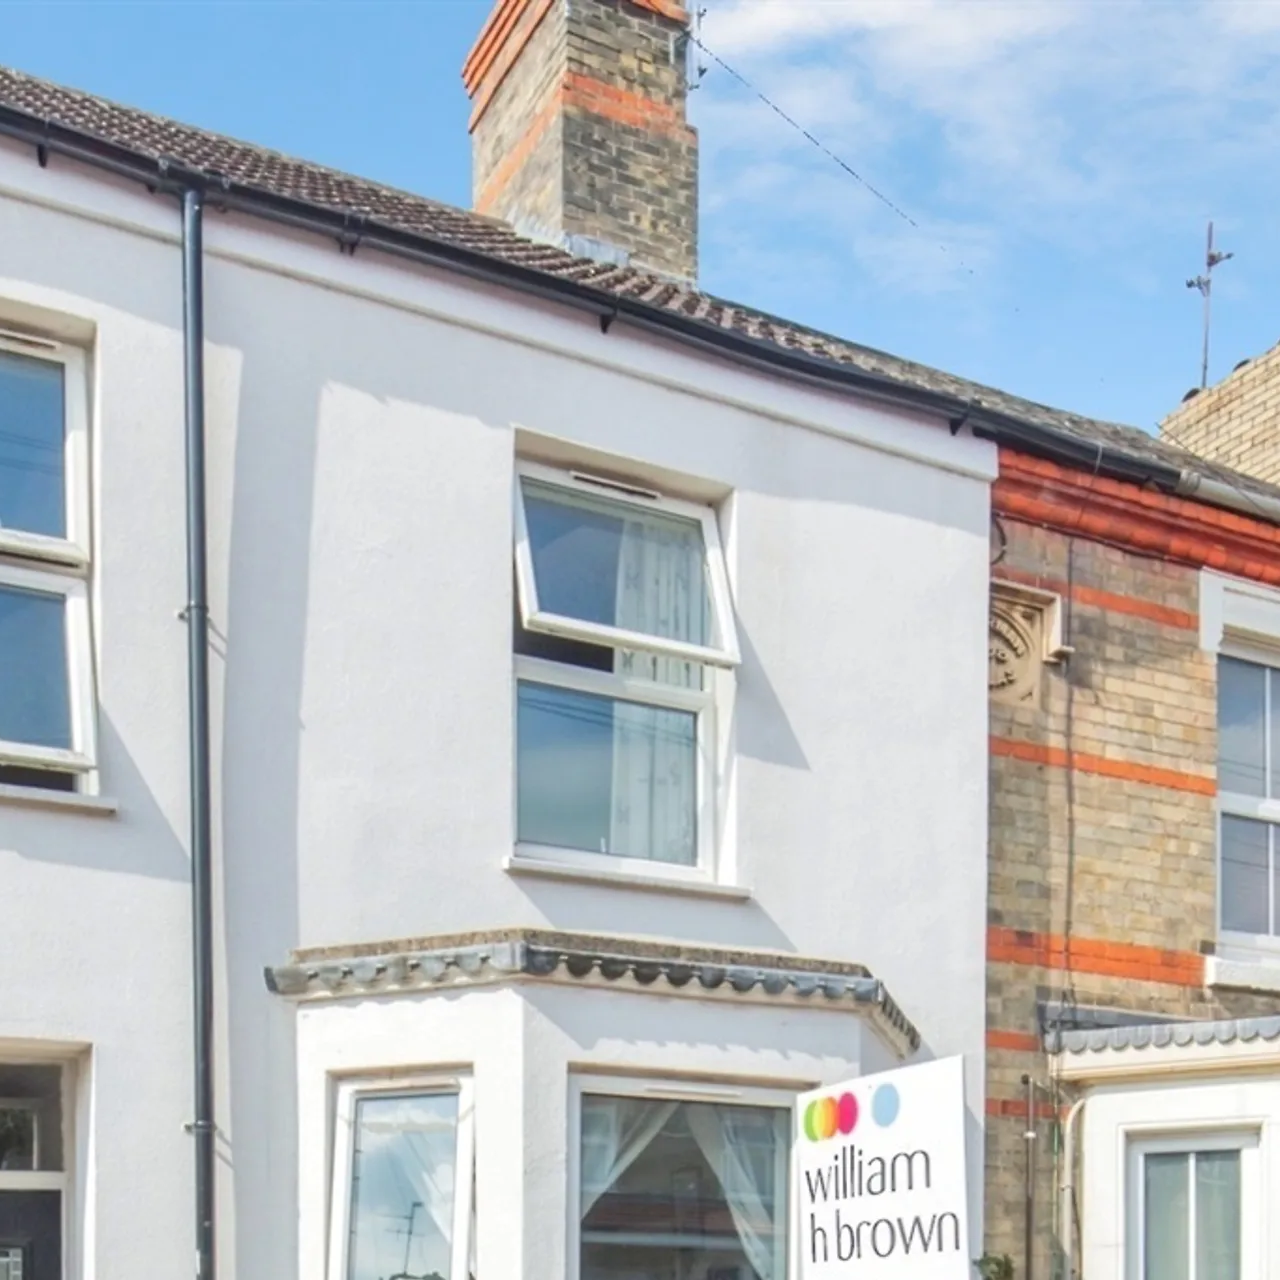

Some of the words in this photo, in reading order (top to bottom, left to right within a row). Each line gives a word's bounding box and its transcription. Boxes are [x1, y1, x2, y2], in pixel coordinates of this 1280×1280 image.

[805, 1144, 931, 1203] william
[810, 1212, 828, 1264] h
[836, 1208, 960, 1262] brown
